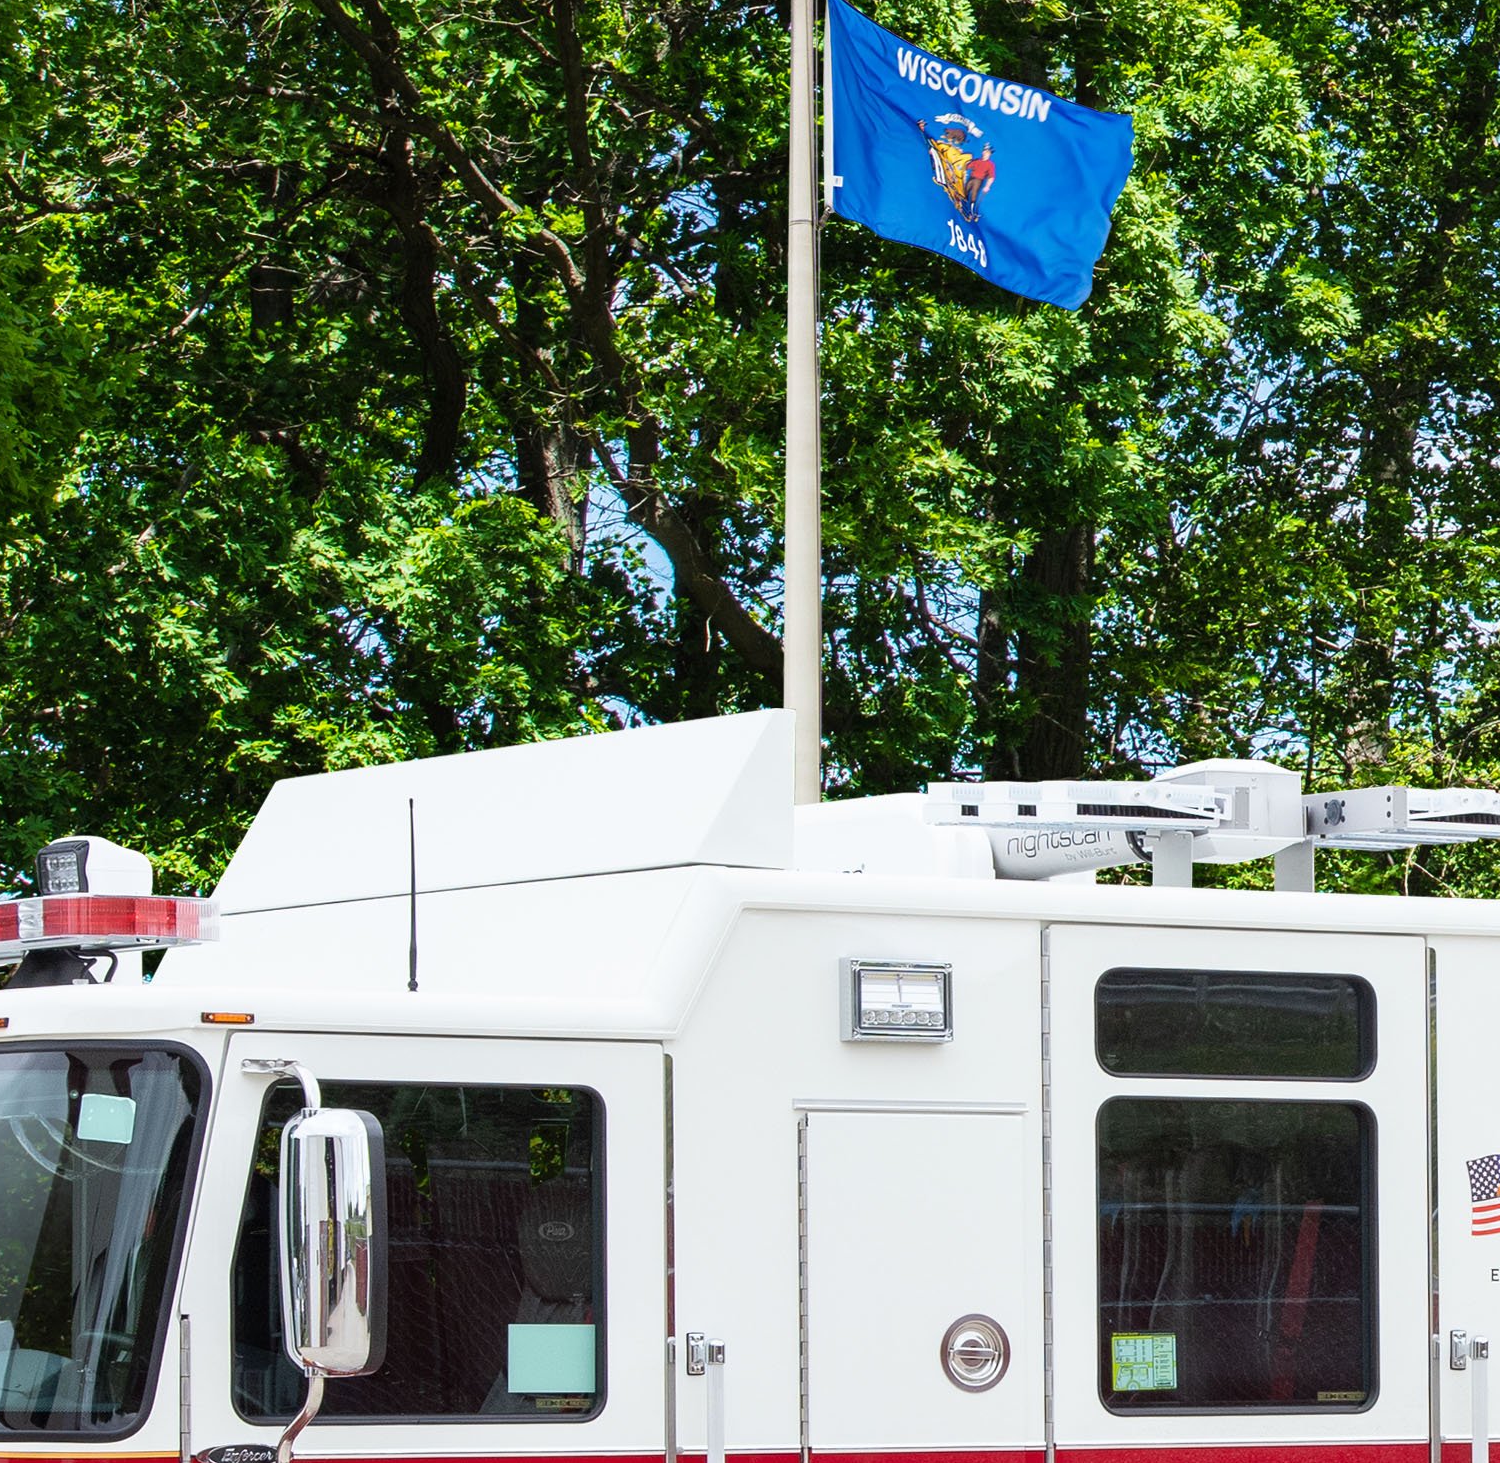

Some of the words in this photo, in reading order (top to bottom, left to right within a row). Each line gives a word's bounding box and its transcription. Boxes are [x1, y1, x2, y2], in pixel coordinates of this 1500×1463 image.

[897, 47, 1052, 122] WISCONSIN
[947, 219, 988, 268] 1848
[1065, 852, 1077, 862] by
